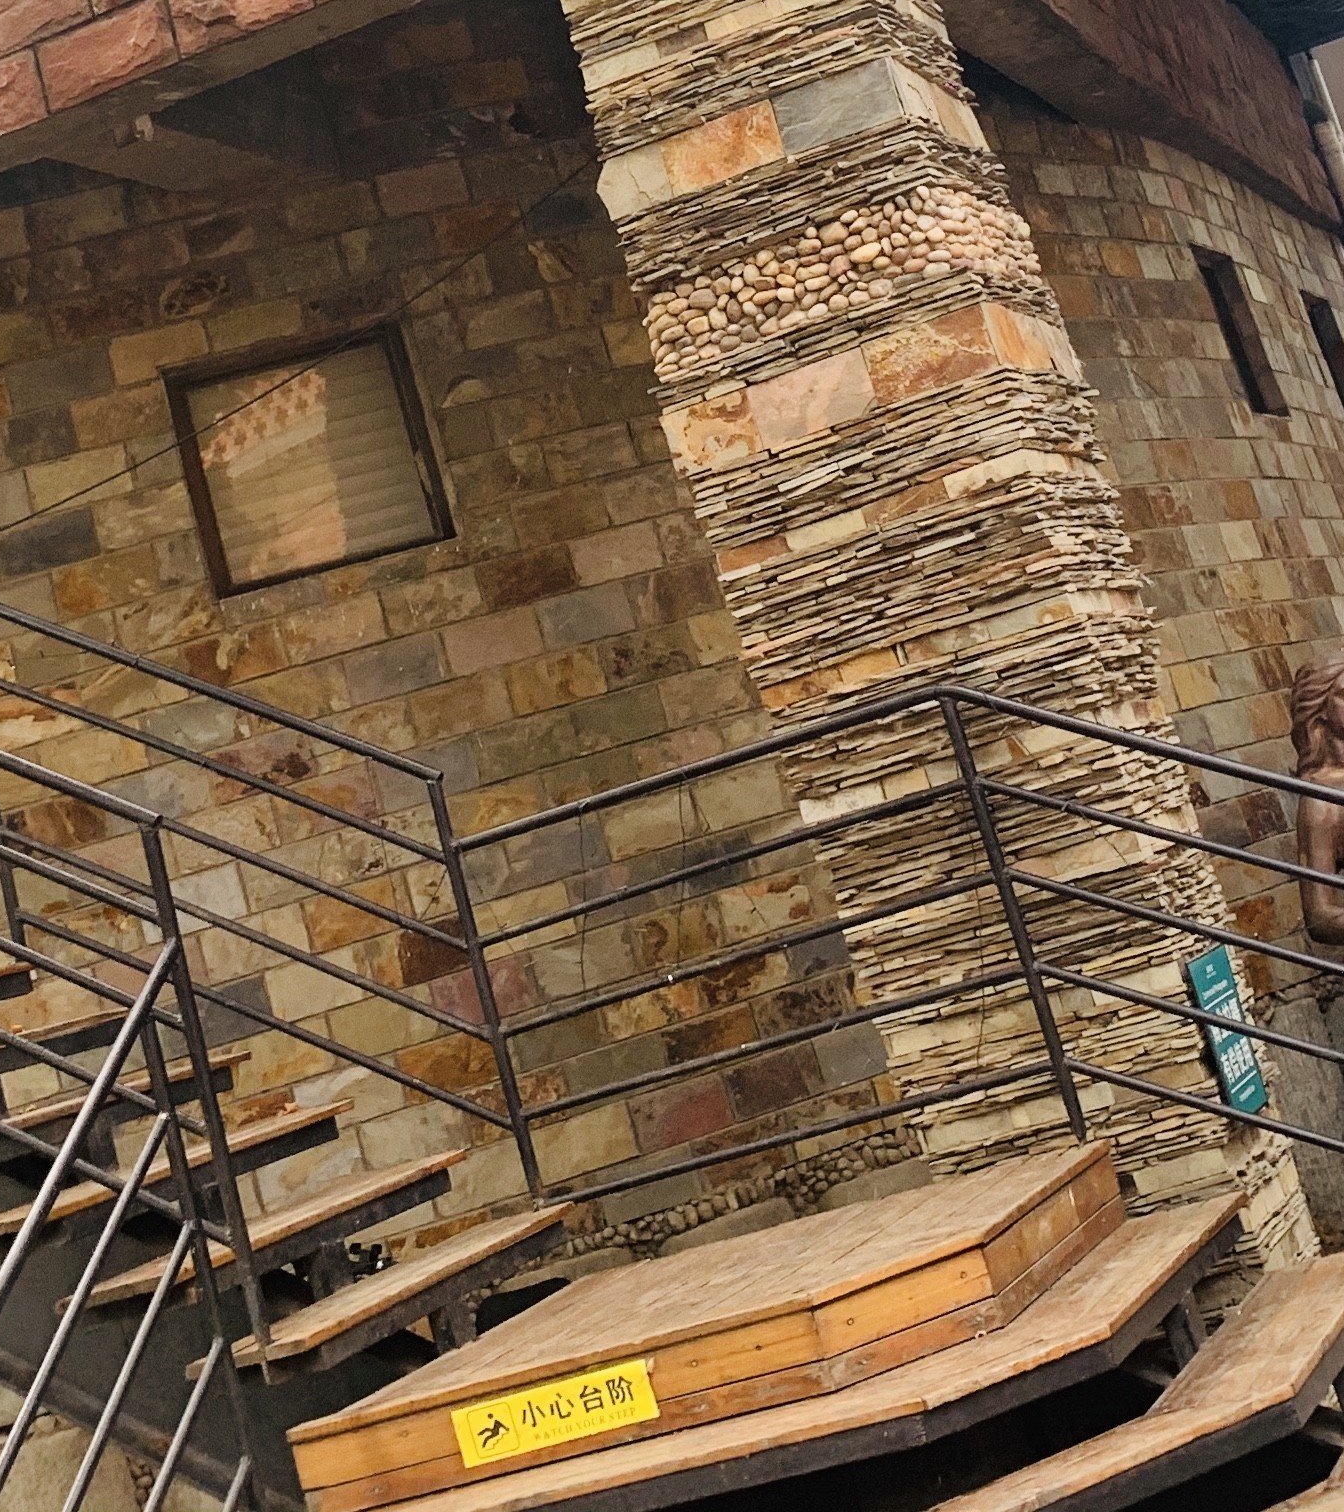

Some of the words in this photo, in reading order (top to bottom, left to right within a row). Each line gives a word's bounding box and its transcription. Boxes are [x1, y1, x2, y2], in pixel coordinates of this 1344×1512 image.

[521, 1375, 635, 1428] 小心台阶
[533, 1423, 574, 1442] WATCH
[574, 1414, 607, 1432] YOUR
[608, 1407, 637, 1422] STEP
